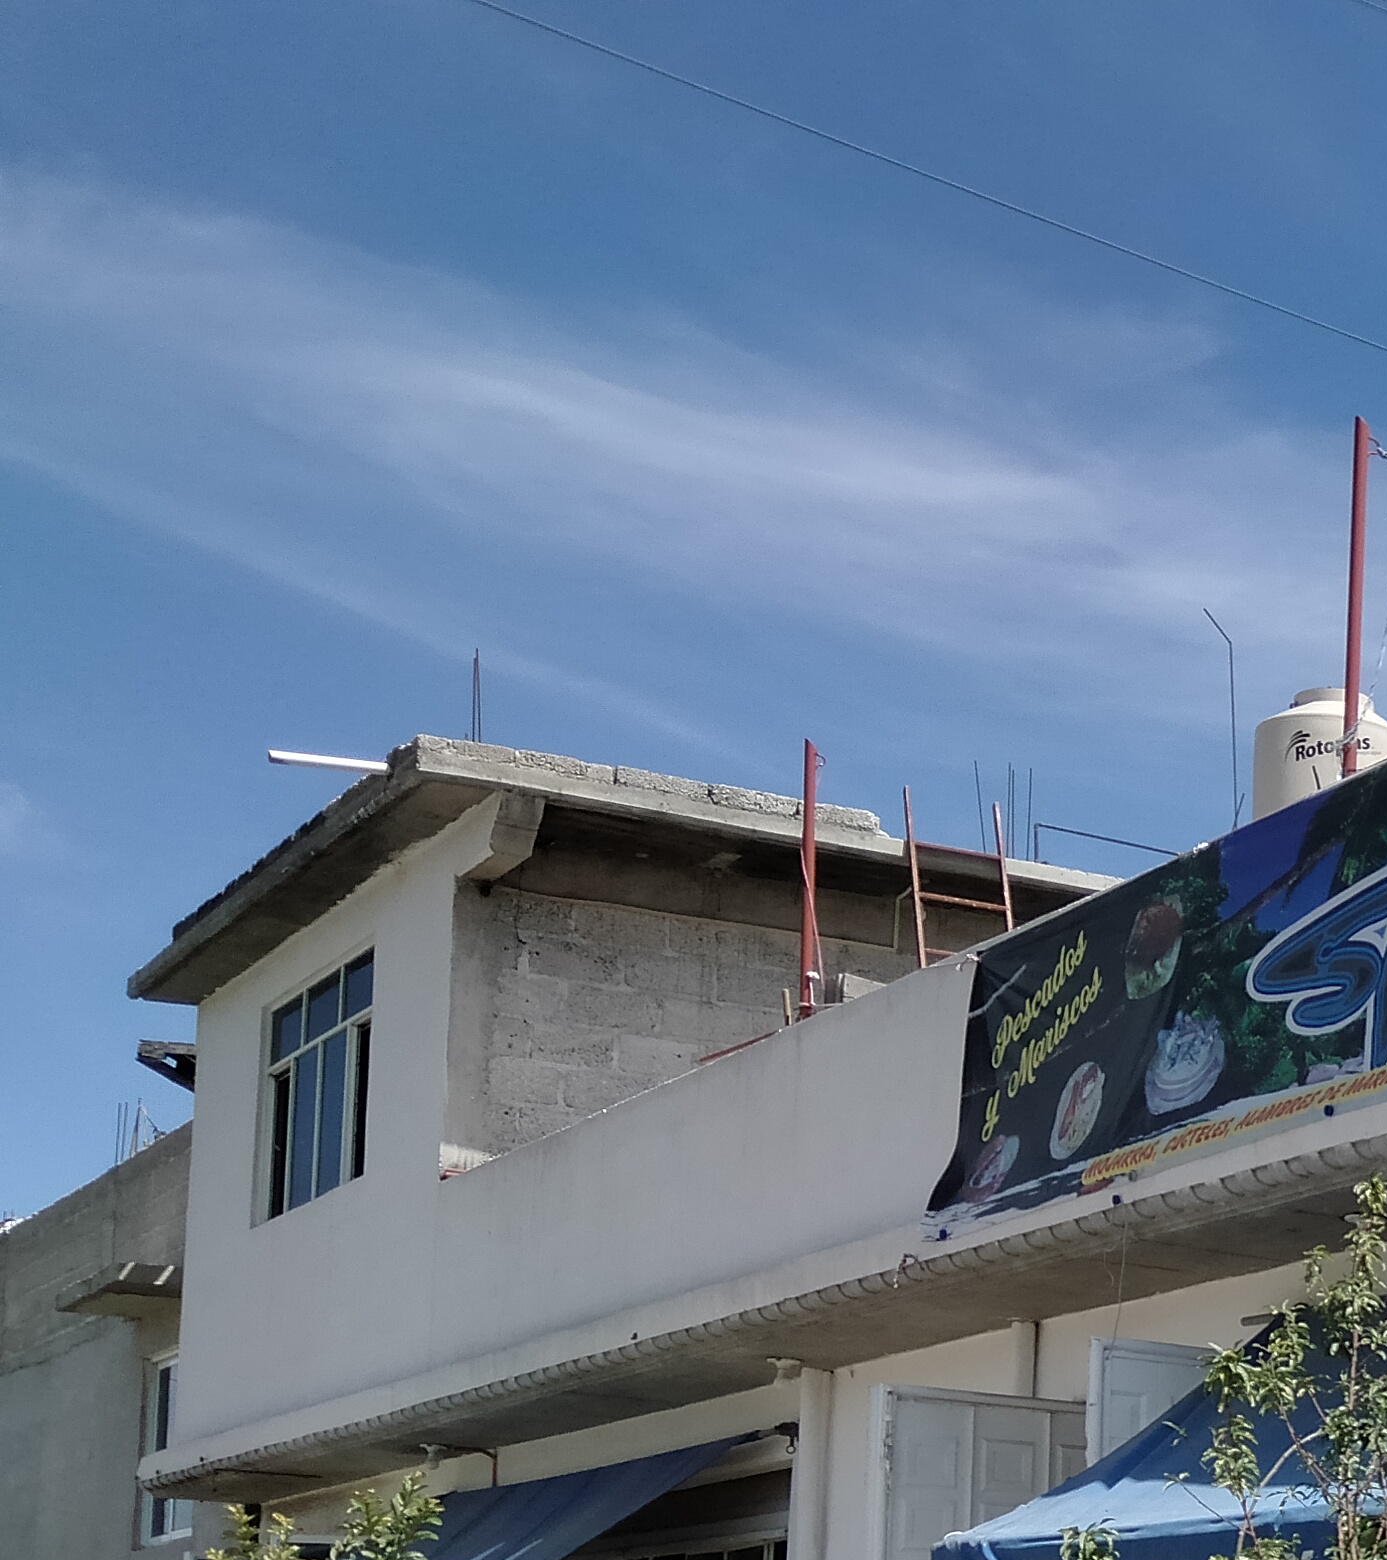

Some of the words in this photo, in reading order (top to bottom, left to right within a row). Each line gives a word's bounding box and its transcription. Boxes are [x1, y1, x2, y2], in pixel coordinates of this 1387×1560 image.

[1295, 736, 1371, 762] Rotoas
[991, 930, 1088, 1069] Pescados
[1007, 966, 1102, 1099] Mariscos
[1083, 1140, 1161, 1179] MOJARRAS,
[1234, 1090, 1322, 1131] ALAMBRES
[1317, 1081, 1346, 1105] DE
